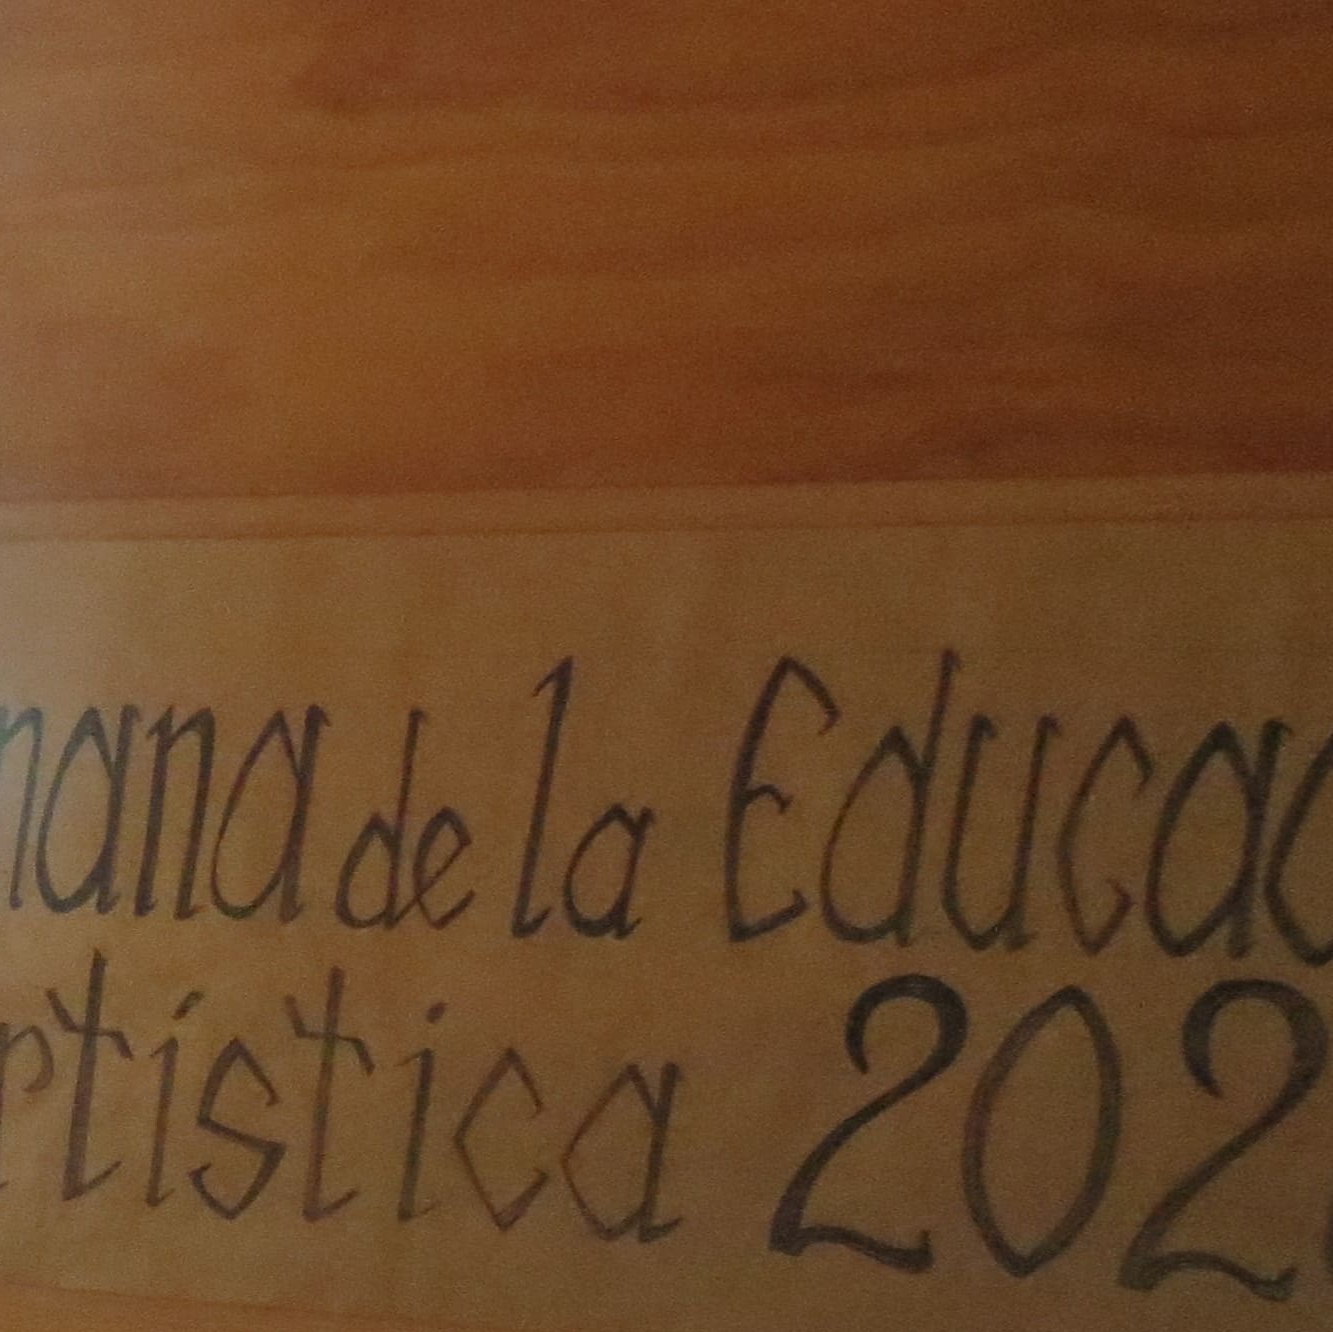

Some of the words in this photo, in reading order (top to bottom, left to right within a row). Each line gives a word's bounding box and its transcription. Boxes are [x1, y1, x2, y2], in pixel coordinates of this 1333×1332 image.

[335, 707, 477, 932] de
[510, 654, 655, 942] la
[768, 973, 1333, 1303] 202
